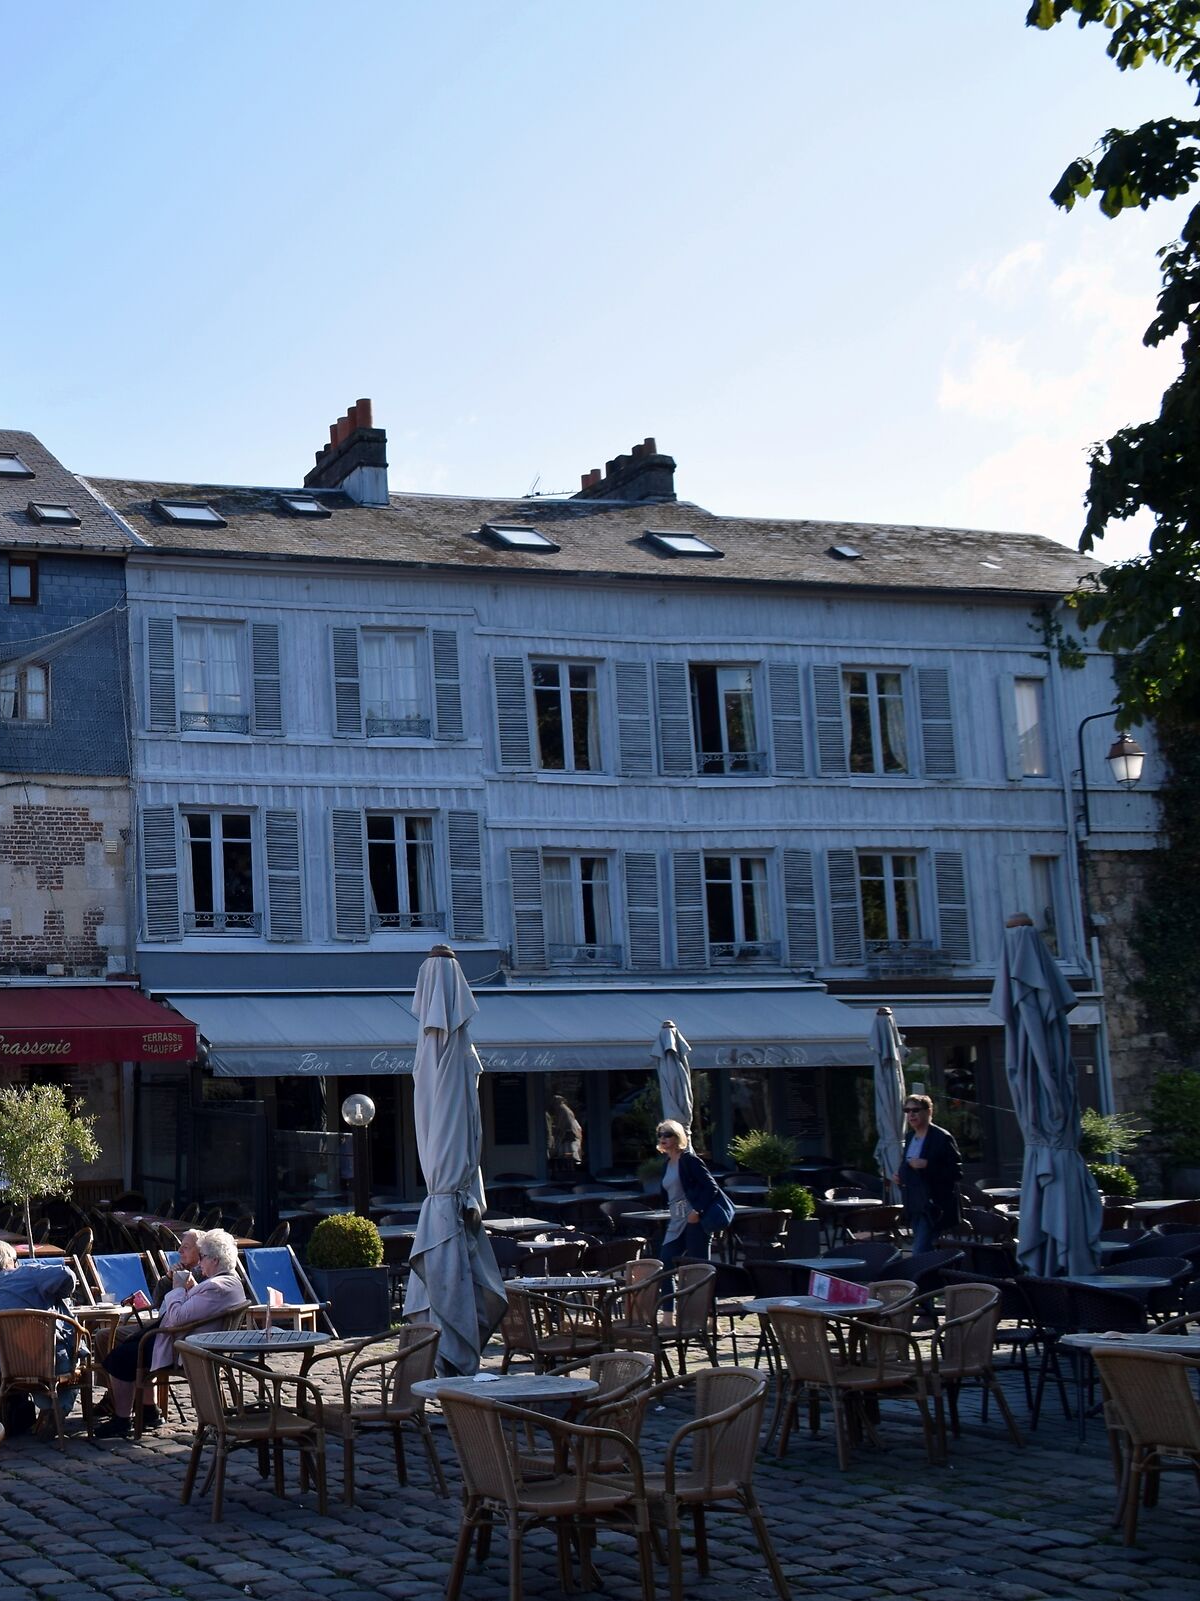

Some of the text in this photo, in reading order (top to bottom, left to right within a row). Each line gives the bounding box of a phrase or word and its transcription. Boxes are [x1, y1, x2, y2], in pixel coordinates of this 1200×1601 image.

[142, 1032, 183, 1042] TERRASSE
[297, 1052, 331, 1072] Bar
[371, 1050, 414, 1074] Crêpe
[534, 1050, 556, 1067] thé
